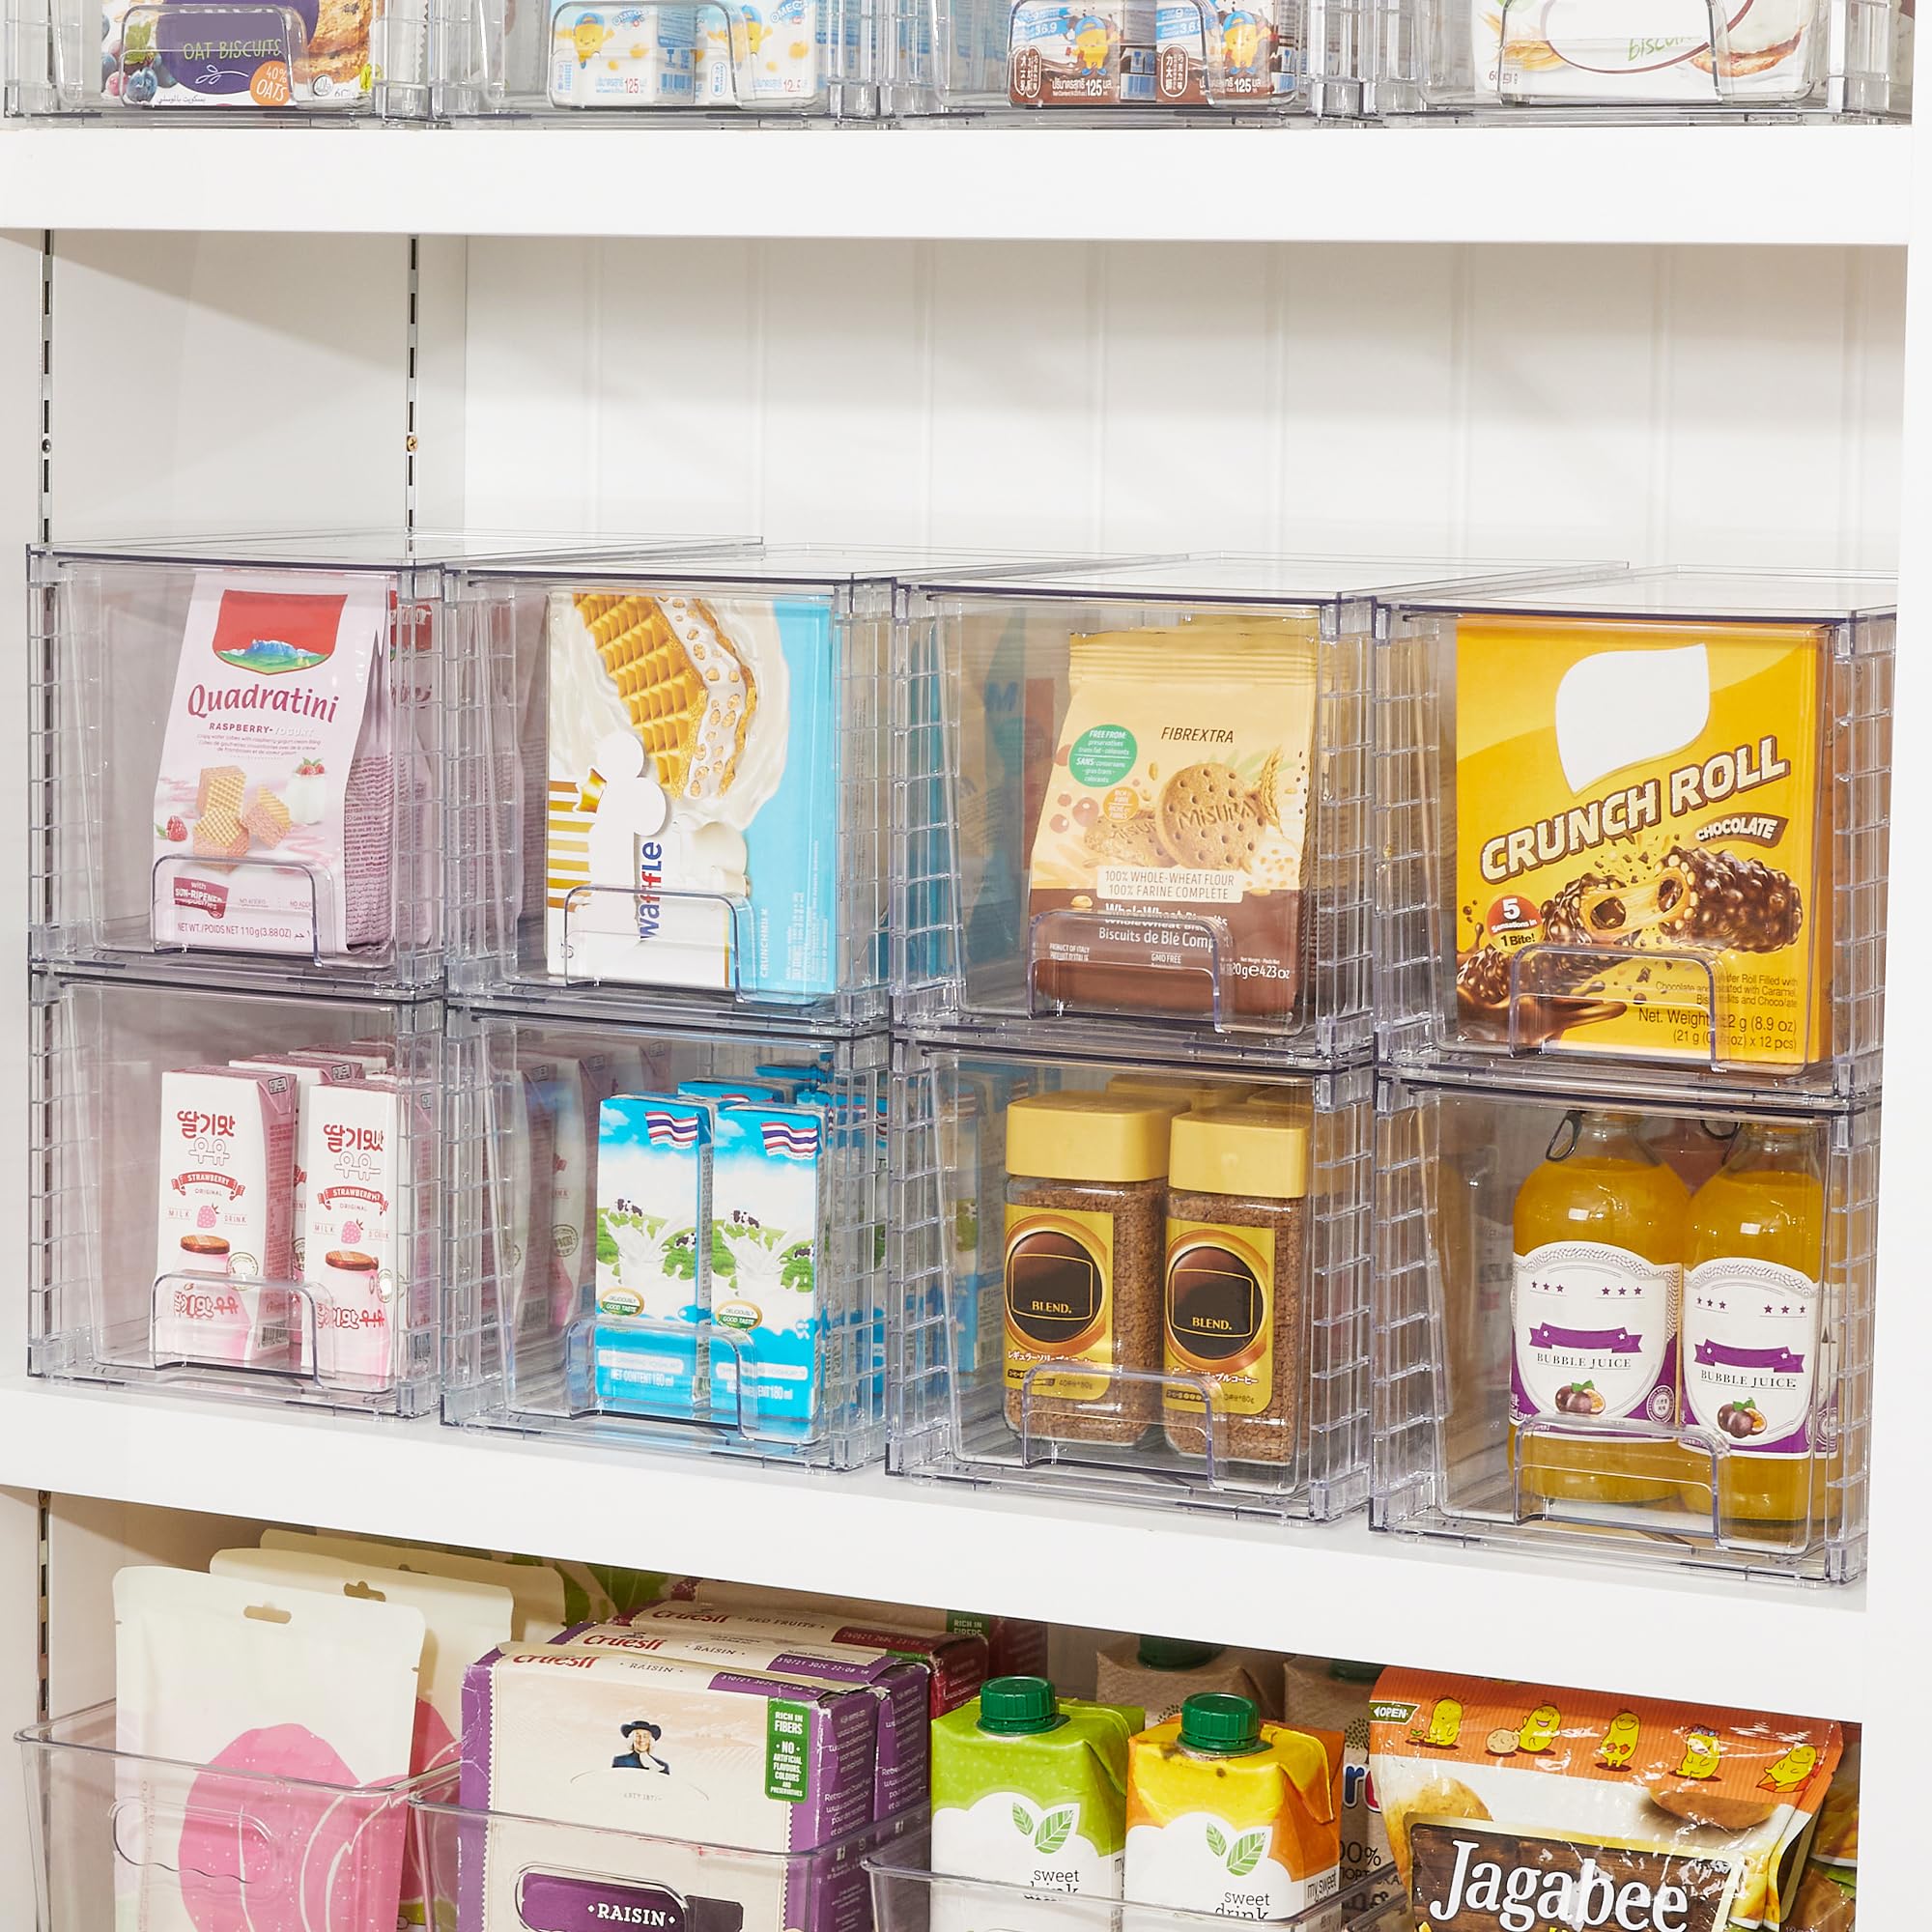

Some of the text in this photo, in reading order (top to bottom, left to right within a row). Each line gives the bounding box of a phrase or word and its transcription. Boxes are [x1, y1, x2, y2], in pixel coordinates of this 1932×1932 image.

[184, 39, 282, 61] OAT BISCUITS
[266, 66, 287, 83] 40%
[256, 79, 287, 101] OATS
[625, 78, 640, 94] 125
[1086, 79, 1103, 97] 125
[1234, 78, 1252, 93] 125
[187, 684, 339, 723] Quadratini
[1160, 726, 1234, 744] FIBREXTRA
[1479, 734, 1792, 885] CRUNCH ROLL
[1694, 817, 1778, 842] CHOCOLATE
[1105, 870, 1234, 886] 100% WHOLE-WHEAT FLOUR
[191, 881, 206, 891] with
[1109, 884, 1133, 895] 100%
[1136, 885, 1173, 898] FARINE
[1502, 897, 1520, 920] 5
[226, 925, 239, 934] NET
[1098, 926, 1221, 953] Biscuits de Blé Comp
[1500, 932, 1536, 947] 1 Bite!
[1166, 953, 1181, 964] FREE
[1742, 974, 1798, 986] Roll Filled with
[1656, 981, 1695, 991] Chocolate
[1744, 985, 1760, 995] with
[1741, 995, 1755, 1005] and
[1758, 996, 1798, 1007] Chocolate
[1638, 1008, 1663, 1023] Net.
[1739, 1018, 1747, 1031] g
[1750, 1015, 1775, 1031] (8.9
[1777, 1020, 1798, 1033] oz)
[1673, 1030, 1689, 1043] (21
[1692, 1033, 1699, 1044] g
[1749, 1037, 1756, 1046] x
[1760, 1037, 1773, 1048] 12
[1775, 1037, 1797, 1050] pcs)
[177, 1110, 236, 1139] 딸기맛
[323, 1123, 384, 1152] 딸기맛
[187, 1173, 230, 1187] STRAWBERRY
[194, 1188, 223, 1197] ORIGINAL
[168, 1209, 190, 1218] MILK
[339, 1203, 368, 1211] ORIGINAL
[224, 1215, 247, 1224] DRINK
[314, 1224, 334, 1234] MILK
[622, 1305, 638, 1314] TASTE
[1032, 1300, 1072, 1314] BLEND.
[738, 1318, 754, 1326] TASTE
[1192, 1317, 1233, 1331] BLEND.
[1537, 1352, 1632, 1370] BUBBLE JUICE
[611, 1371, 622, 1381] NET
[1701, 1370, 1795, 1388] BUBBLE JUICE
[953, 1619, 972, 1628] RICH
[583, 1634, 737, 1655] Cruesli RAISIN
[629, 1662, 674, 1673] RAISIN
[775, 1711, 804, 1722] RICH IN
[1379, 1706, 1407, 1719] OPEN
[774, 1720, 803, 1735] FIBERS
[781, 1741, 795, 1754] NO
[773, 1753, 803, 1765] ARTIFICIAL
[773, 1762, 802, 1775] FLAVOURS,
[775, 1773, 800, 1783] COLOURS
[1034, 1870, 1079, 1883] sweet
[1429, 1839, 1688, 1932] Jagabee
[1224, 1891, 1270, 1906] sweet
[597, 1903, 666, 1927] RAISIN
